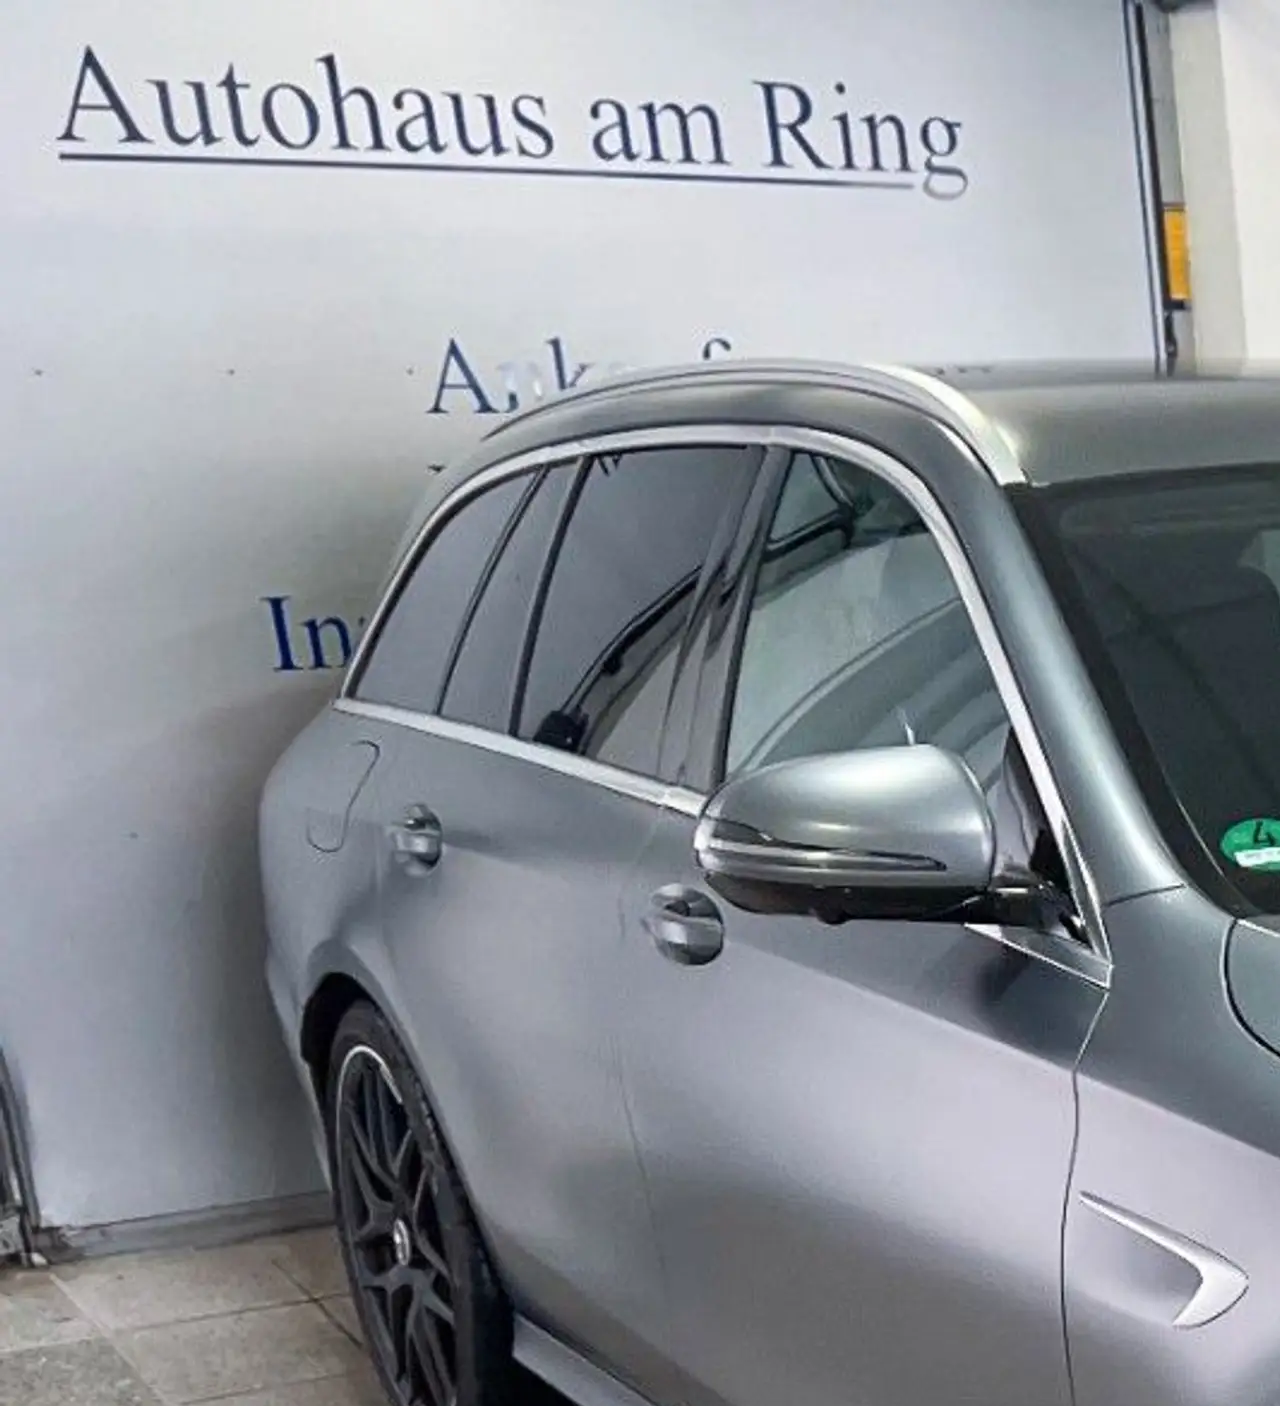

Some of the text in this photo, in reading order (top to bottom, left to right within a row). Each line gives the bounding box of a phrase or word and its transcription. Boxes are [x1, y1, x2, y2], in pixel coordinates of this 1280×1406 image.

[56, 45, 969, 200] Autohaus am Ring
